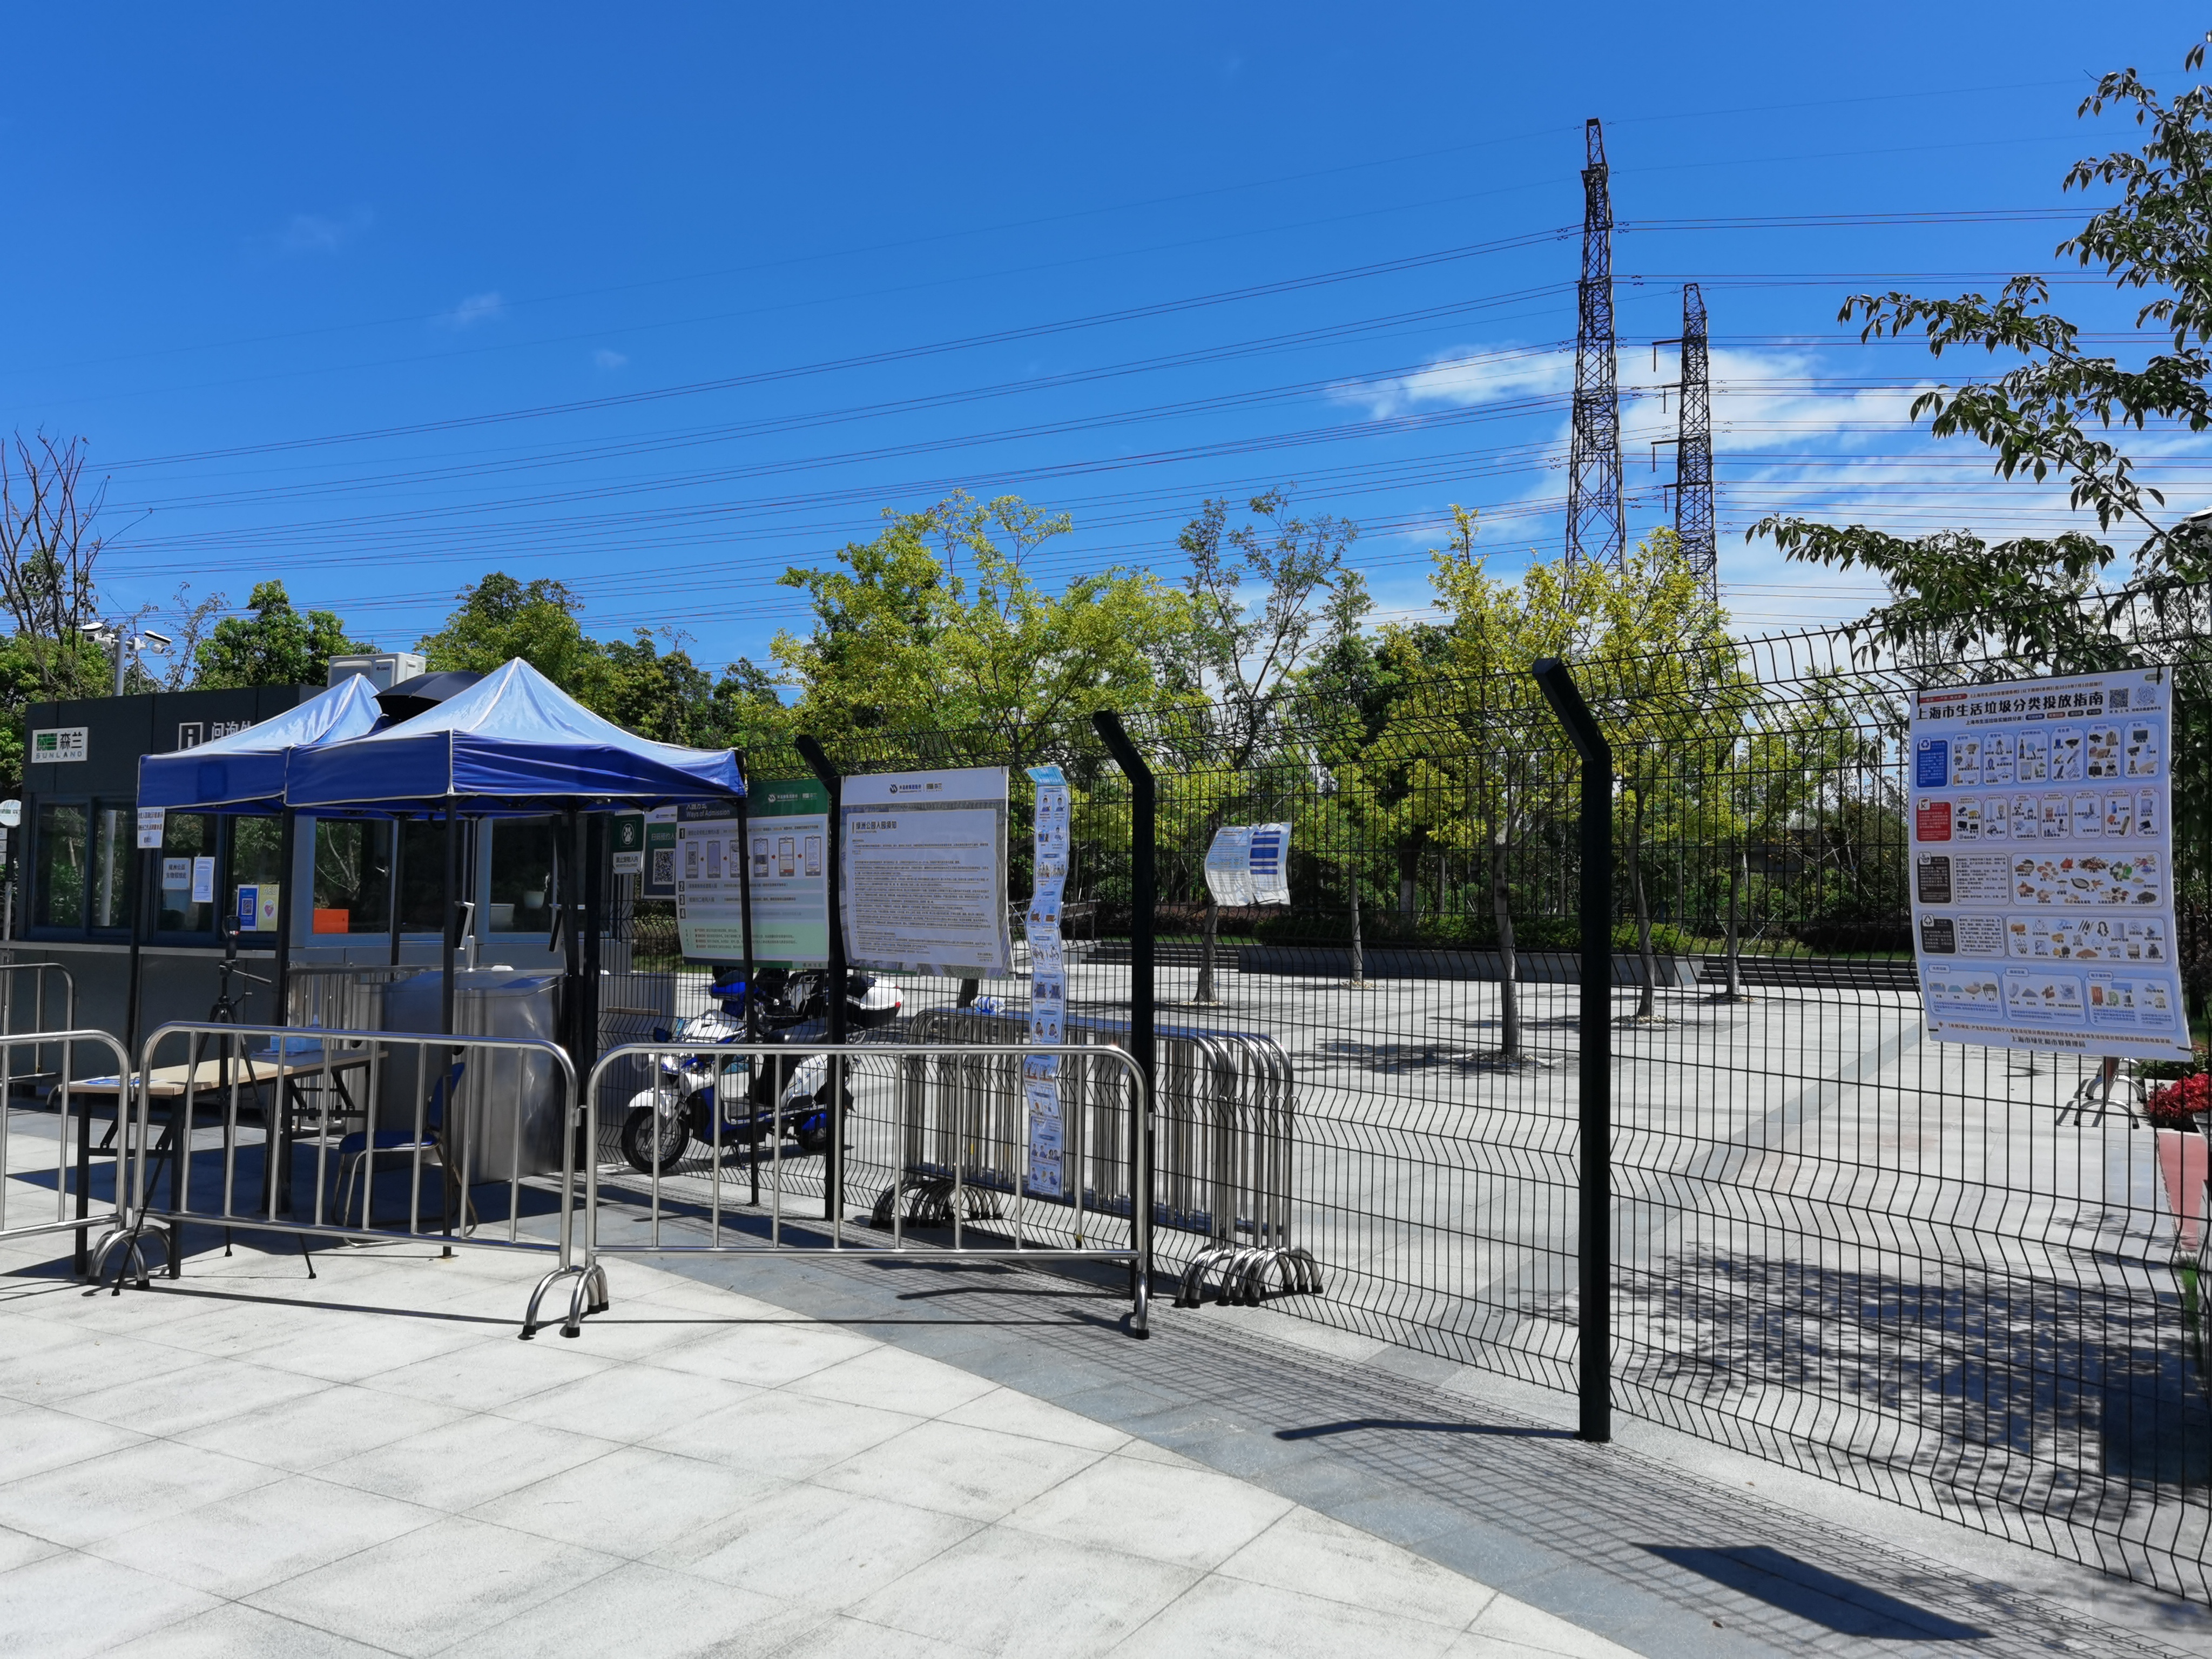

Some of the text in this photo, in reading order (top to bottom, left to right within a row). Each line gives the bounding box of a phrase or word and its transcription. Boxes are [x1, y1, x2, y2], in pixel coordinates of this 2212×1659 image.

[1916, 692, 2103, 720] 上海市生活垃圾分类投放指南
[59, 732, 82, 750] 森兰
